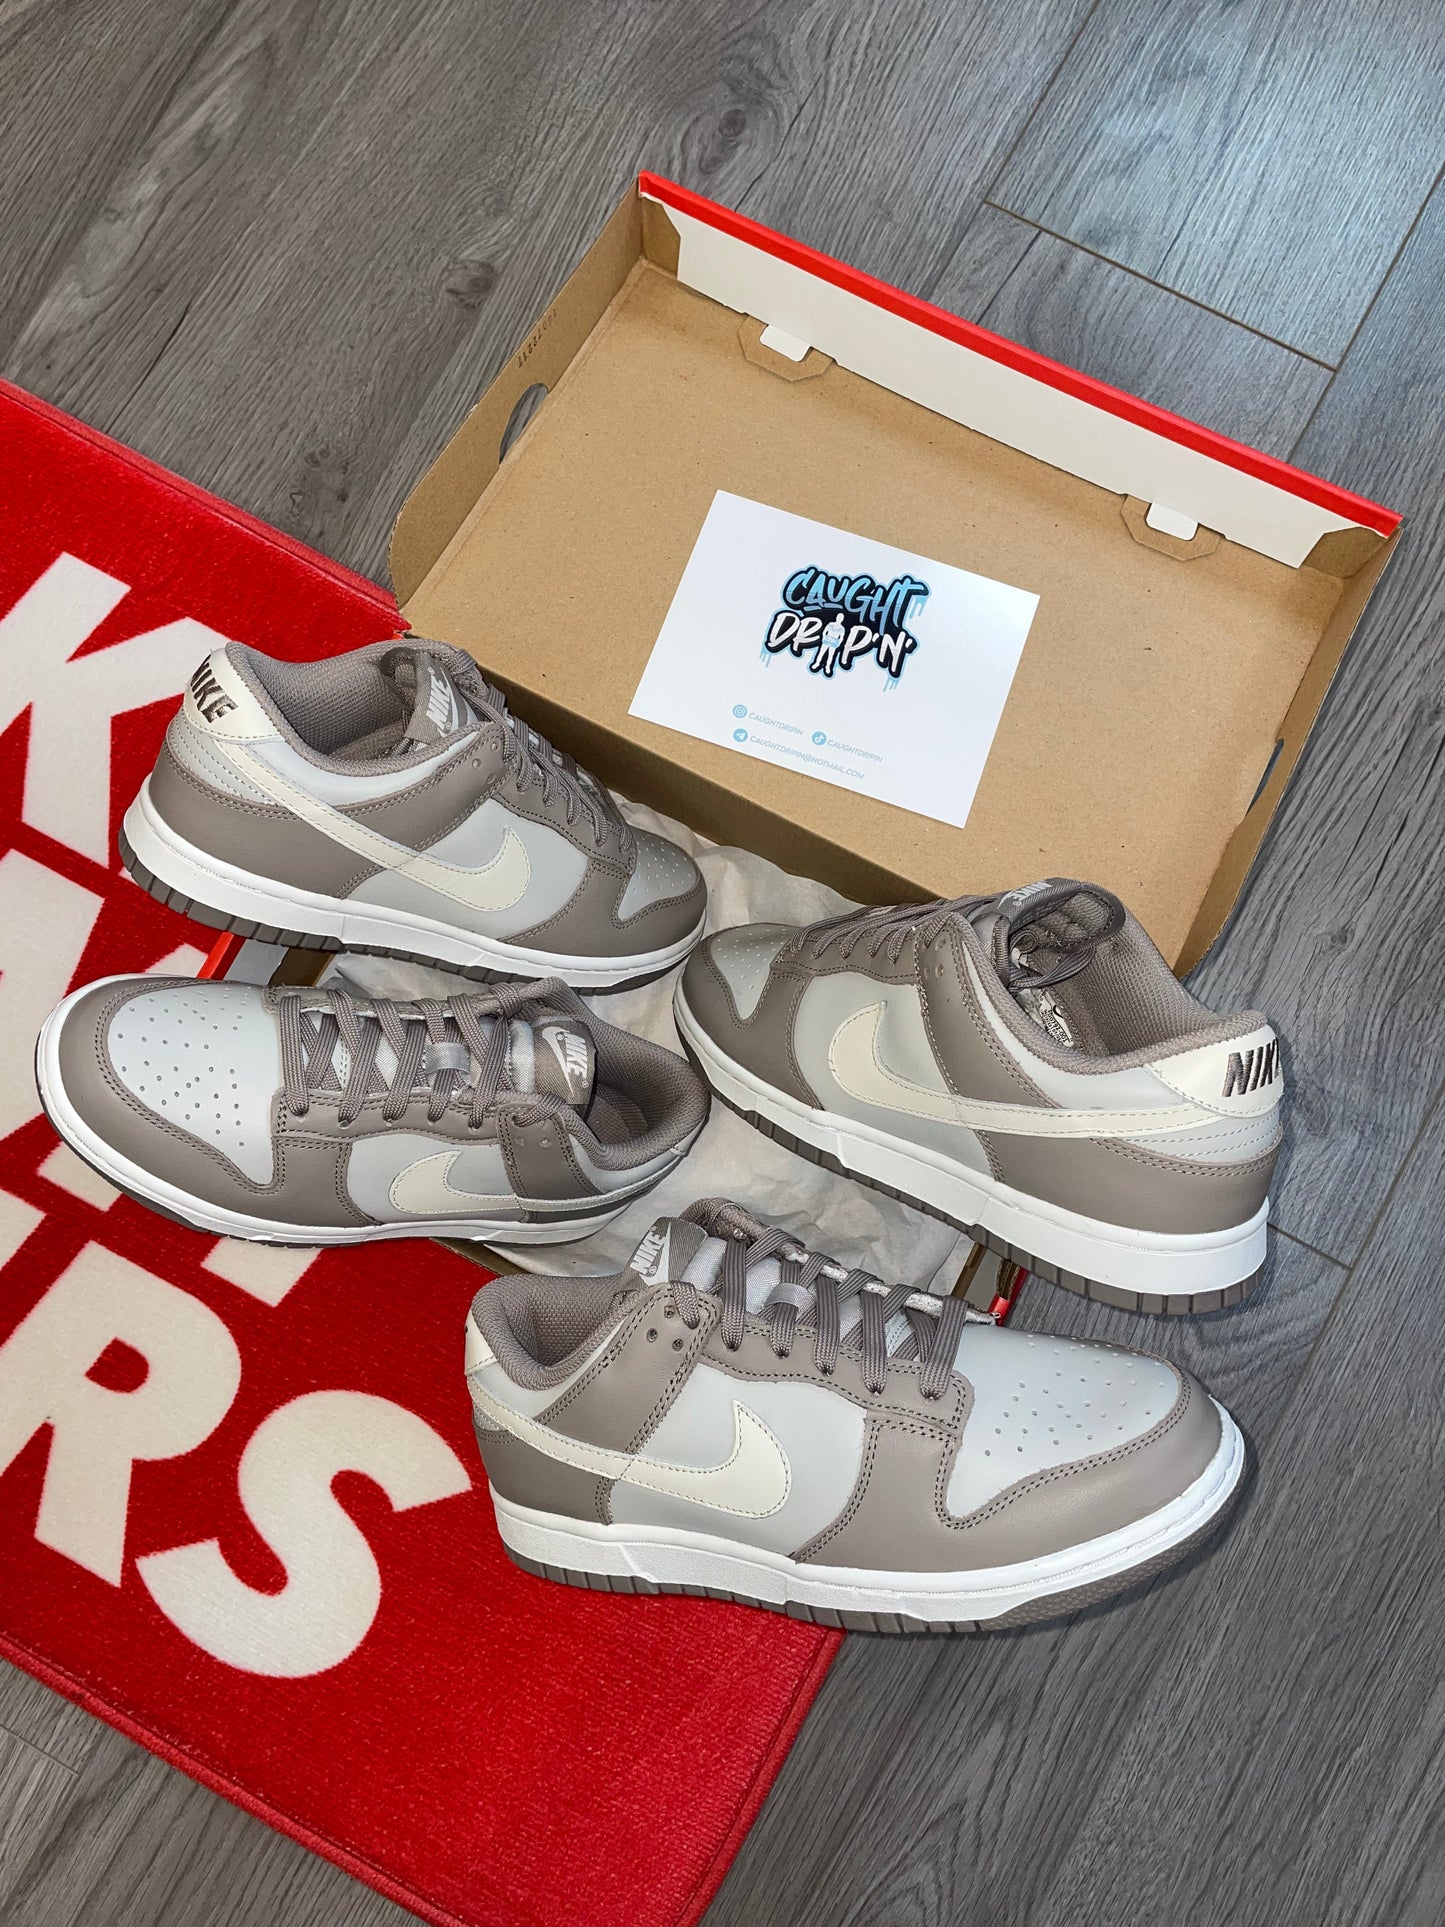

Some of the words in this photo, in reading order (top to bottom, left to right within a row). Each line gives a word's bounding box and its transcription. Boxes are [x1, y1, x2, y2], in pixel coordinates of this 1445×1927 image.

[784, 567, 926, 637] CAUGHT
[190, 653, 239, 723] NIKE
[426, 675, 451, 730] NIKE
[748, 712, 805, 736] CAUGHTDRIPIN
[749, 735, 865, 780] CAUGHTDRIPIN@HOTMAIL.COM
[827, 739, 884, 763] CAUGHTDRIPIN
[1011, 880, 1053, 901] NIKE
[563, 1032, 588, 1079] NIKE
[629, 1231, 666, 1276] NIKE
